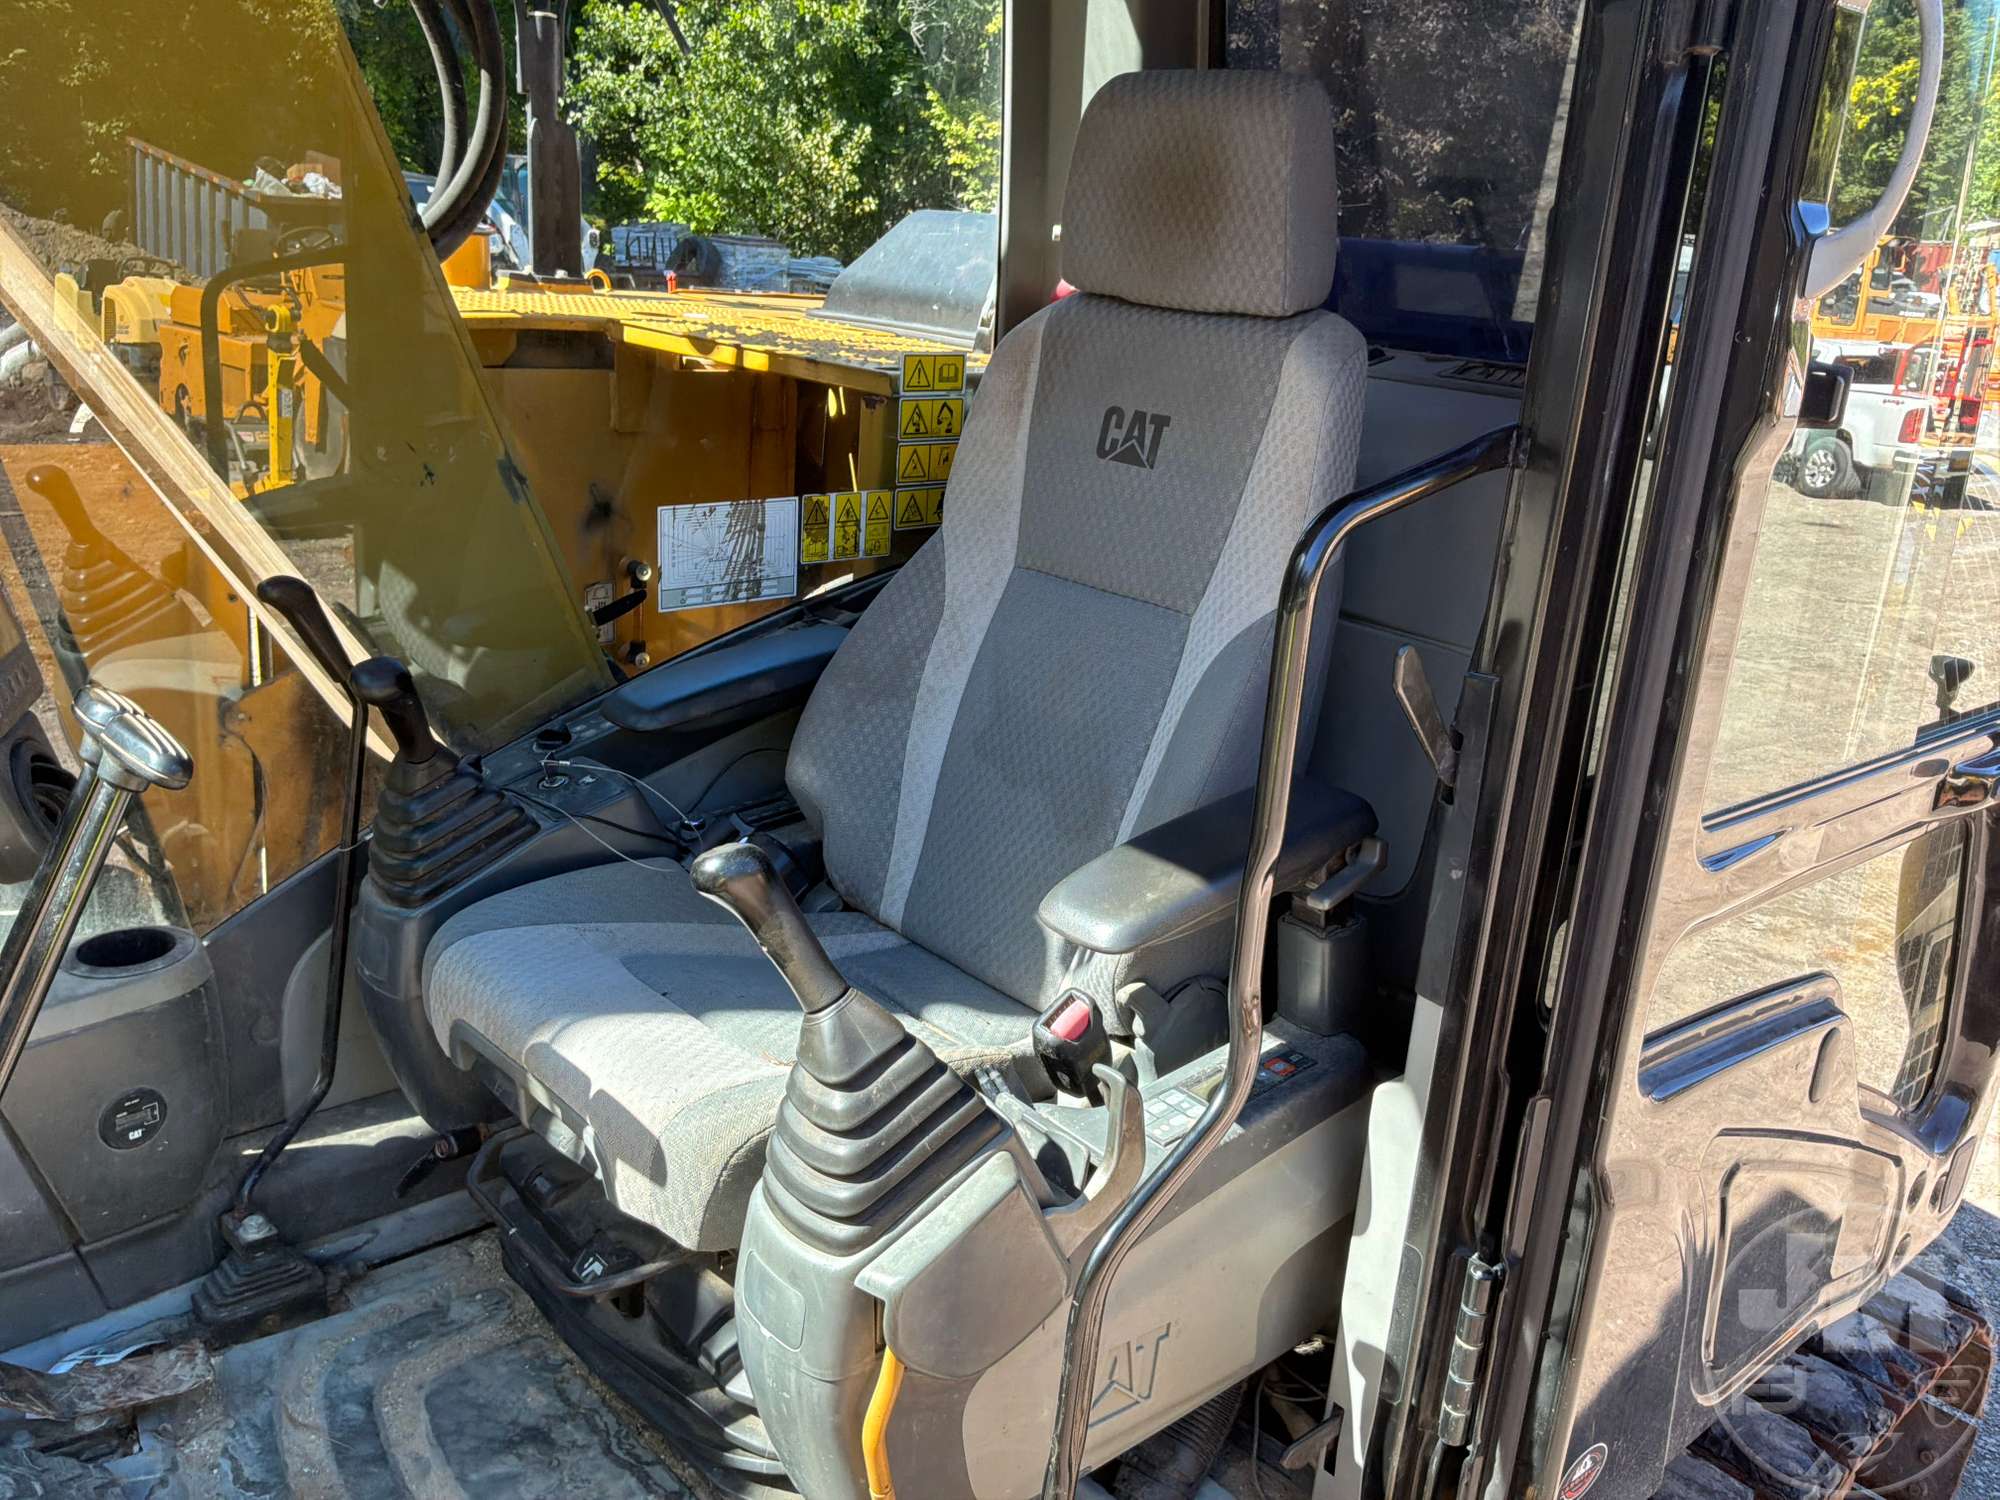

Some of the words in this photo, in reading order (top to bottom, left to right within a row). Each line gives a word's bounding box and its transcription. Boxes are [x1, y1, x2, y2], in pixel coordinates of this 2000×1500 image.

[1096, 405, 1171, 470] CAT
[128, 1129, 143, 1140] CAT
[1087, 1321, 1171, 1428] AT
